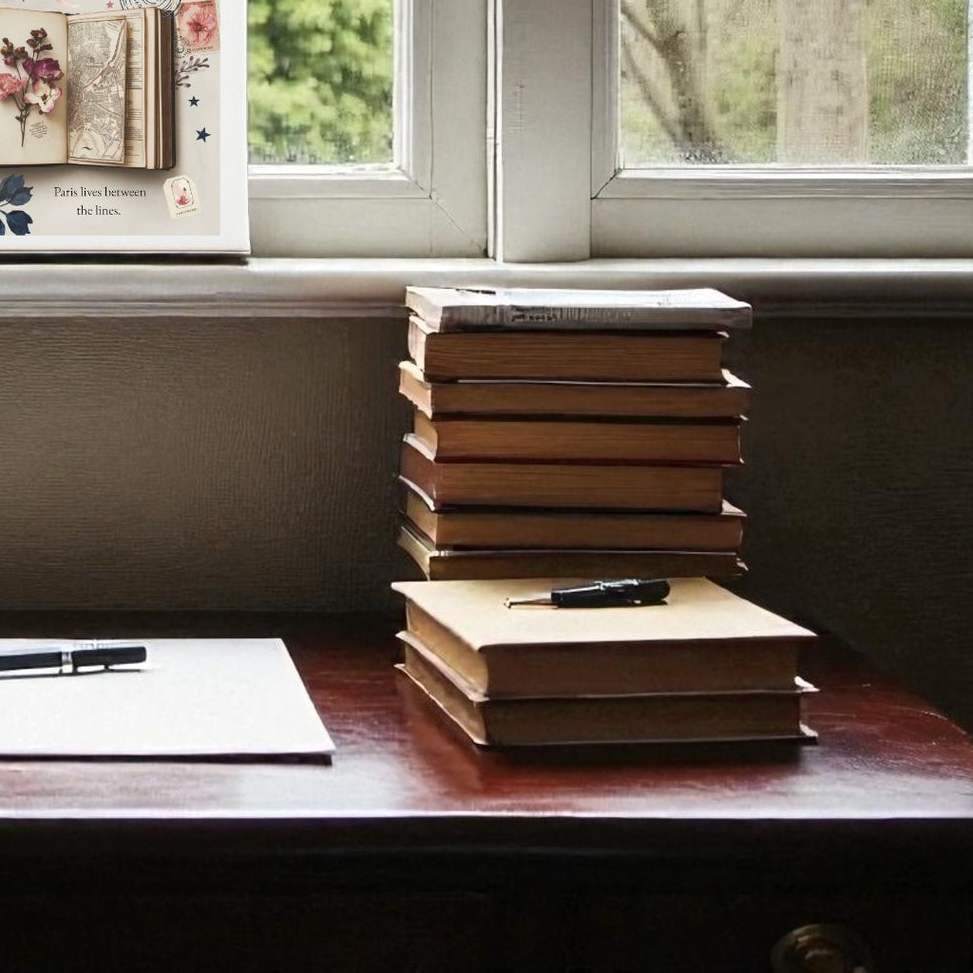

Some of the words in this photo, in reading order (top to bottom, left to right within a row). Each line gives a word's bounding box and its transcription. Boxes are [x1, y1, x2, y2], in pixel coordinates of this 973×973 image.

[54, 187, 77, 197] Paris
[81, 186, 102, 197] lives
[104, 187, 146, 197] between
[77, 205, 93, 216] the
[95, 205, 121, 216] lines.
